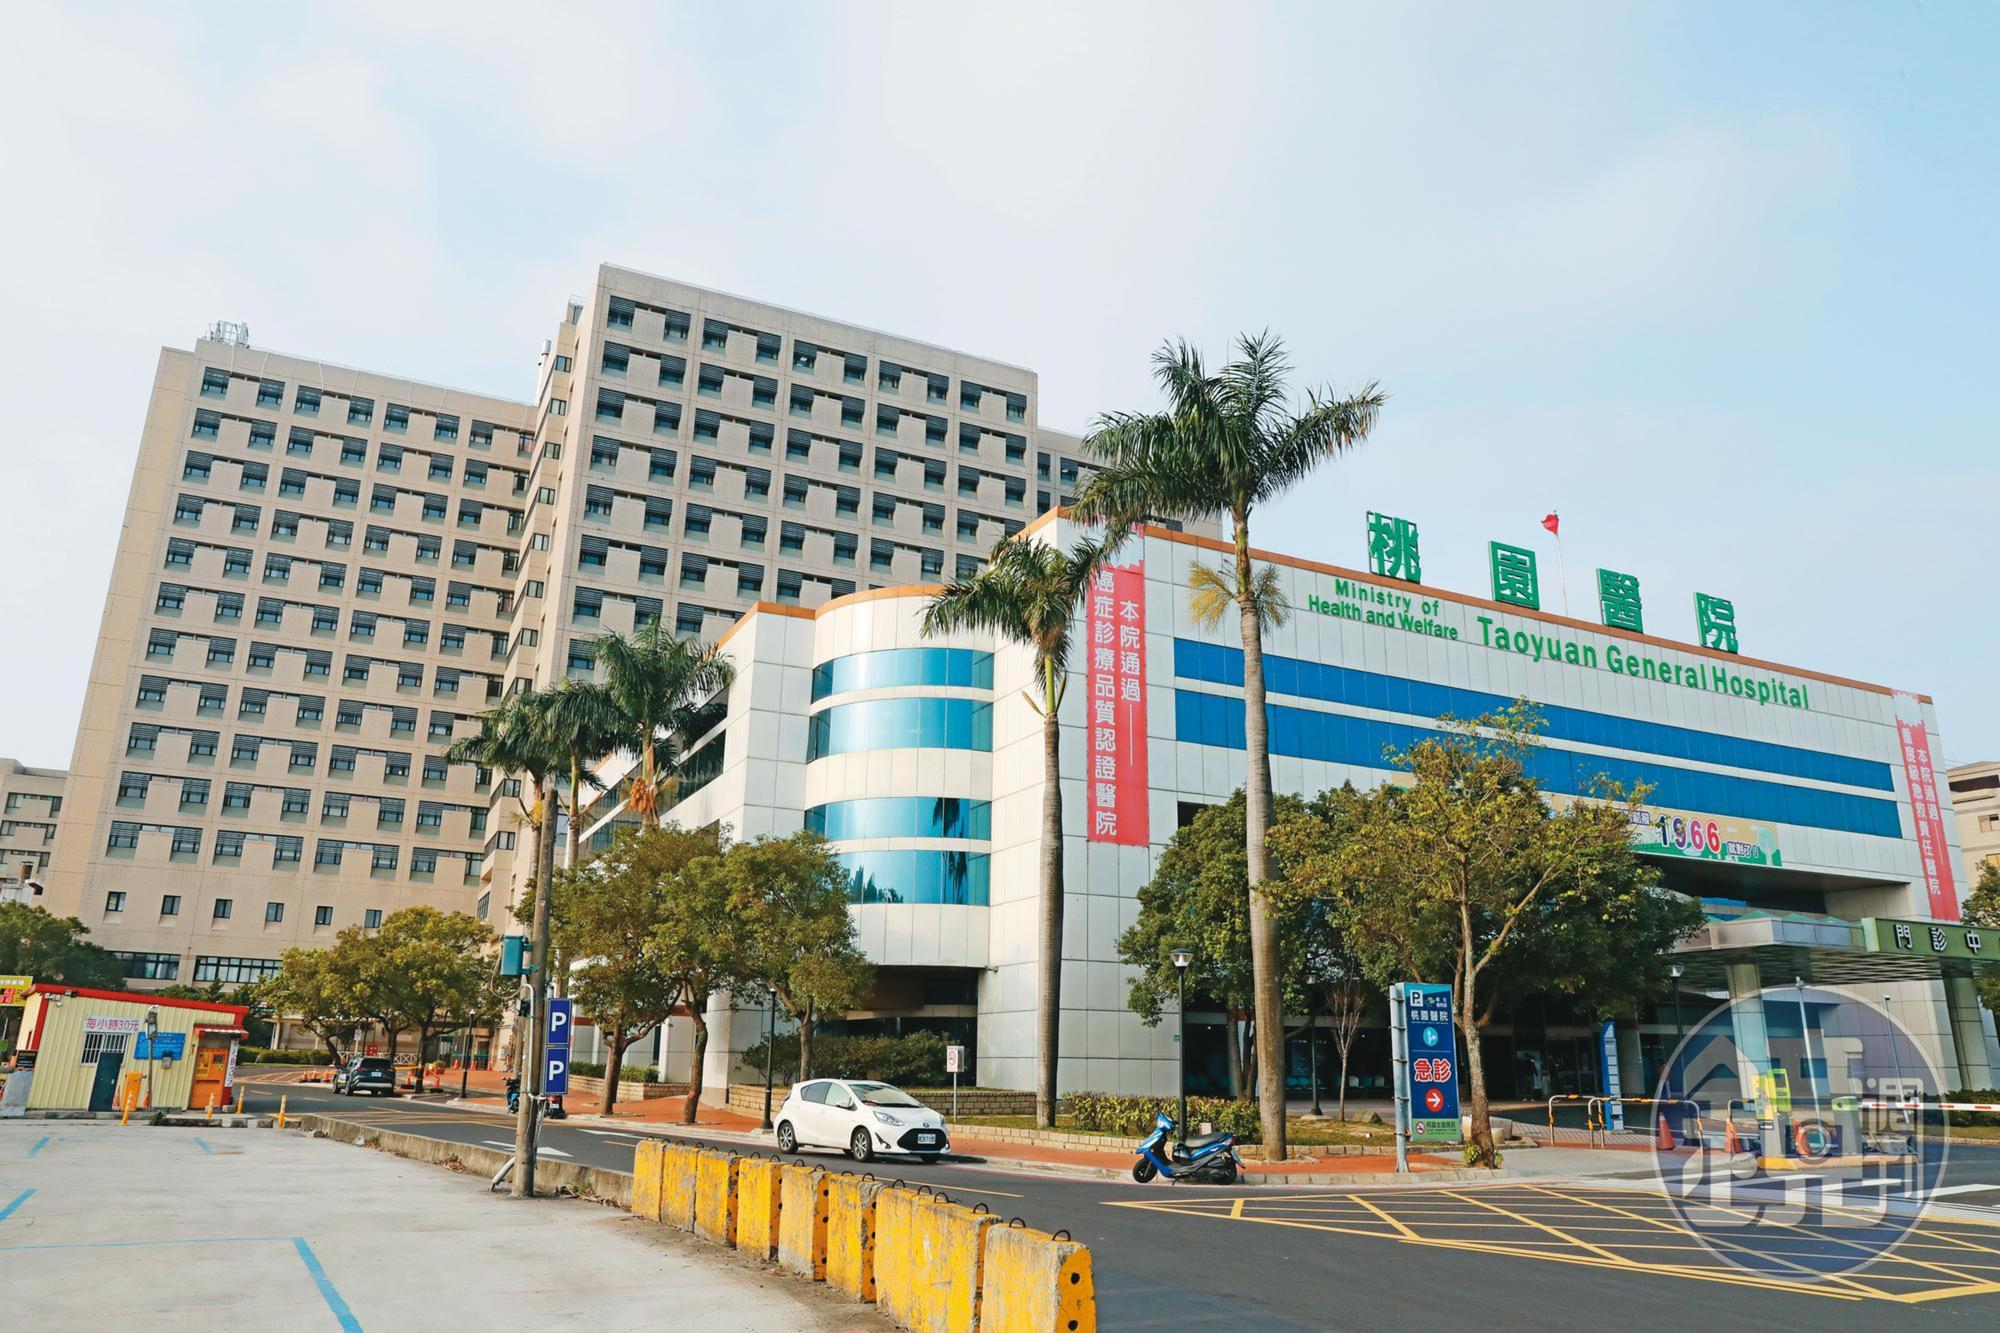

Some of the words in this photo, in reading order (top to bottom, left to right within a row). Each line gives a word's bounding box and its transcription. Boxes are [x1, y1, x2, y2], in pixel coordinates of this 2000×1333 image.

[1334, 578, 1411, 613] Ministry
[1421, 600, 1440, 616] of
[1367, 510, 1739, 654] 桃園醫院
[1308, 594, 1361, 620] Health
[1366, 609, 1395, 628] and
[1398, 612, 1458, 641] Welfare
[1119, 600, 1141, 702] 本院通過
[1476, 616, 1598, 668] Taoyuan
[1606, 645, 1707, 690] General
[1712, 665, 1810, 710] Hospital
[1094, 570, 1118, 837] 癌症診療品質認證醫院
[1917, 748, 1939, 821] 本院通過
[1655, 814, 1722, 853] 1966
[1902, 728, 1941, 896] 重度級急救責任醫院
[1412, 992, 1420, 1004] P
[86, 1017, 140, 1032] 每小時30元
[551, 1012, 567, 1032] P
[548, 1060, 565, 1081] P
[1413, 1058, 1452, 1083] 急診
